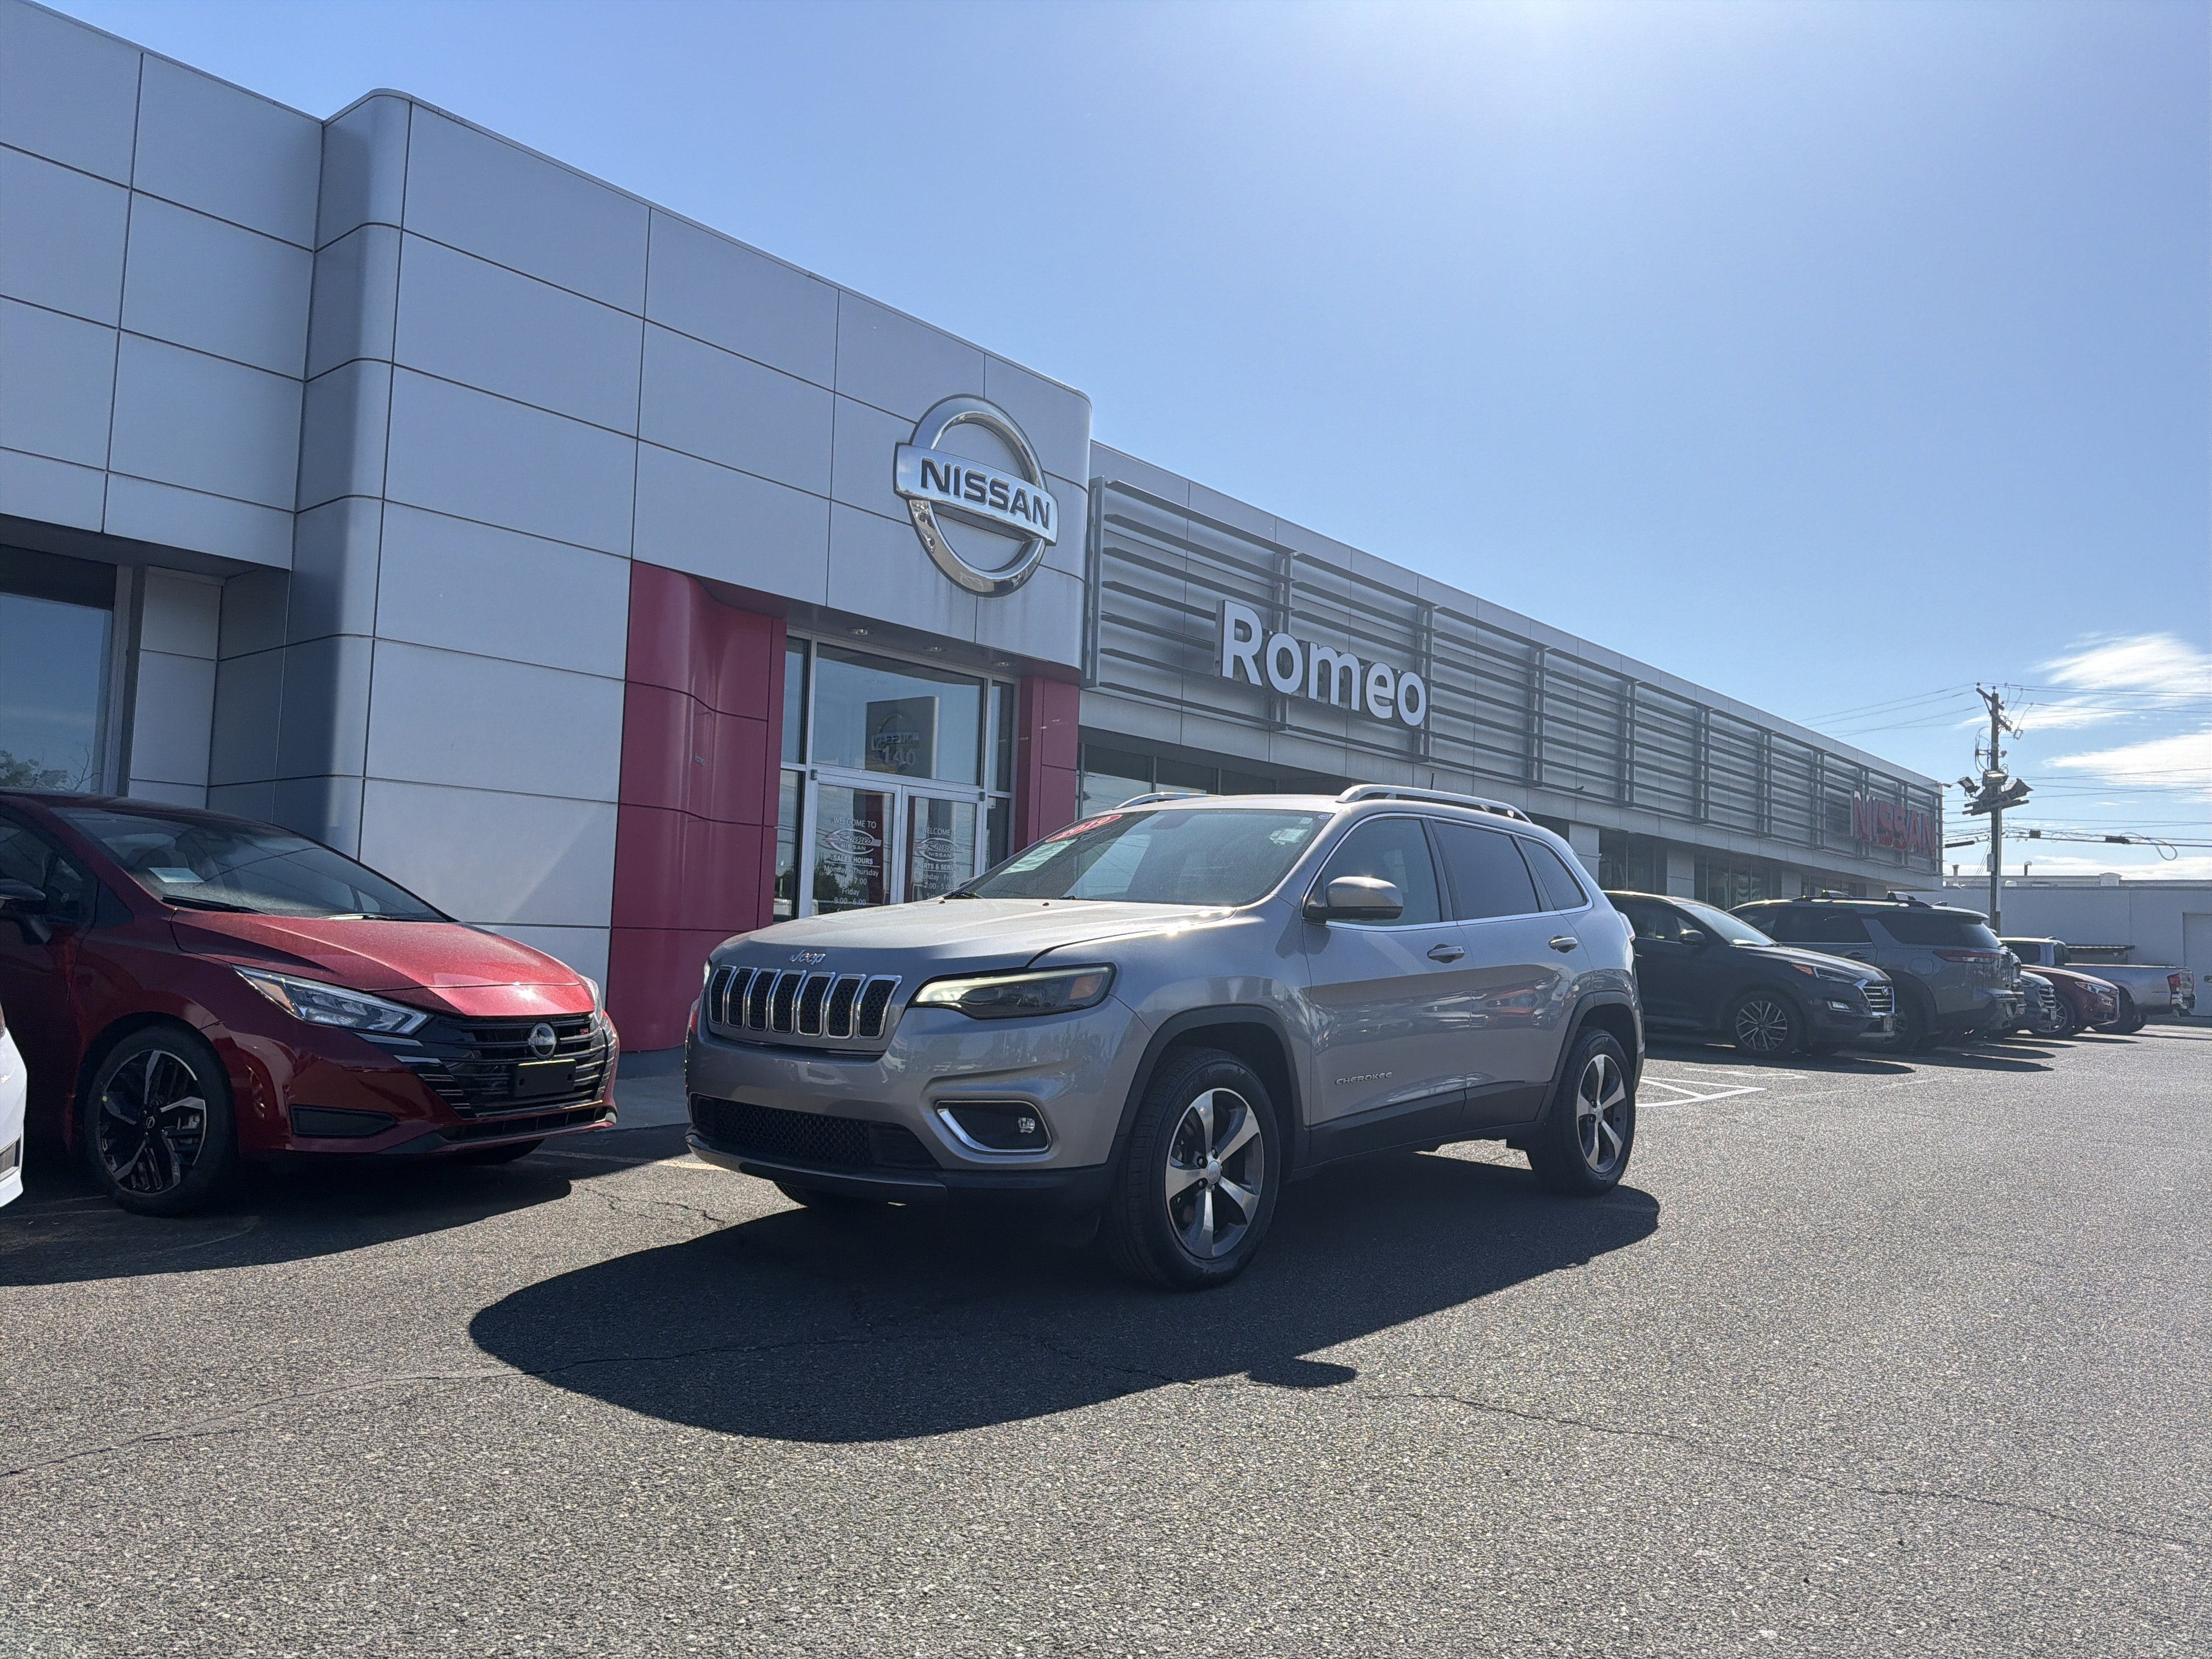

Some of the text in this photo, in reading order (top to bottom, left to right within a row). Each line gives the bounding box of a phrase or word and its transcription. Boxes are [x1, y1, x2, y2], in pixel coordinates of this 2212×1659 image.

[920, 457, 1050, 530] NISSAN
[1219, 599, 1426, 726] Romeo
[833, 816, 877, 829] WELCOME TO
[1853, 790, 1936, 859] NISSAN
[836, 830, 872, 844] Romeo
[922, 827, 951, 836] WELCOME
[833, 854, 873, 865] SALES HOURS
[824, 865, 879, 878] Monday Thursday
[944, 874, 958, 882] Frid
[842, 887, 860, 896] Friday
[790, 949, 826, 966] Jeep
[1335, 1071, 1393, 1085] CHEROKEE
